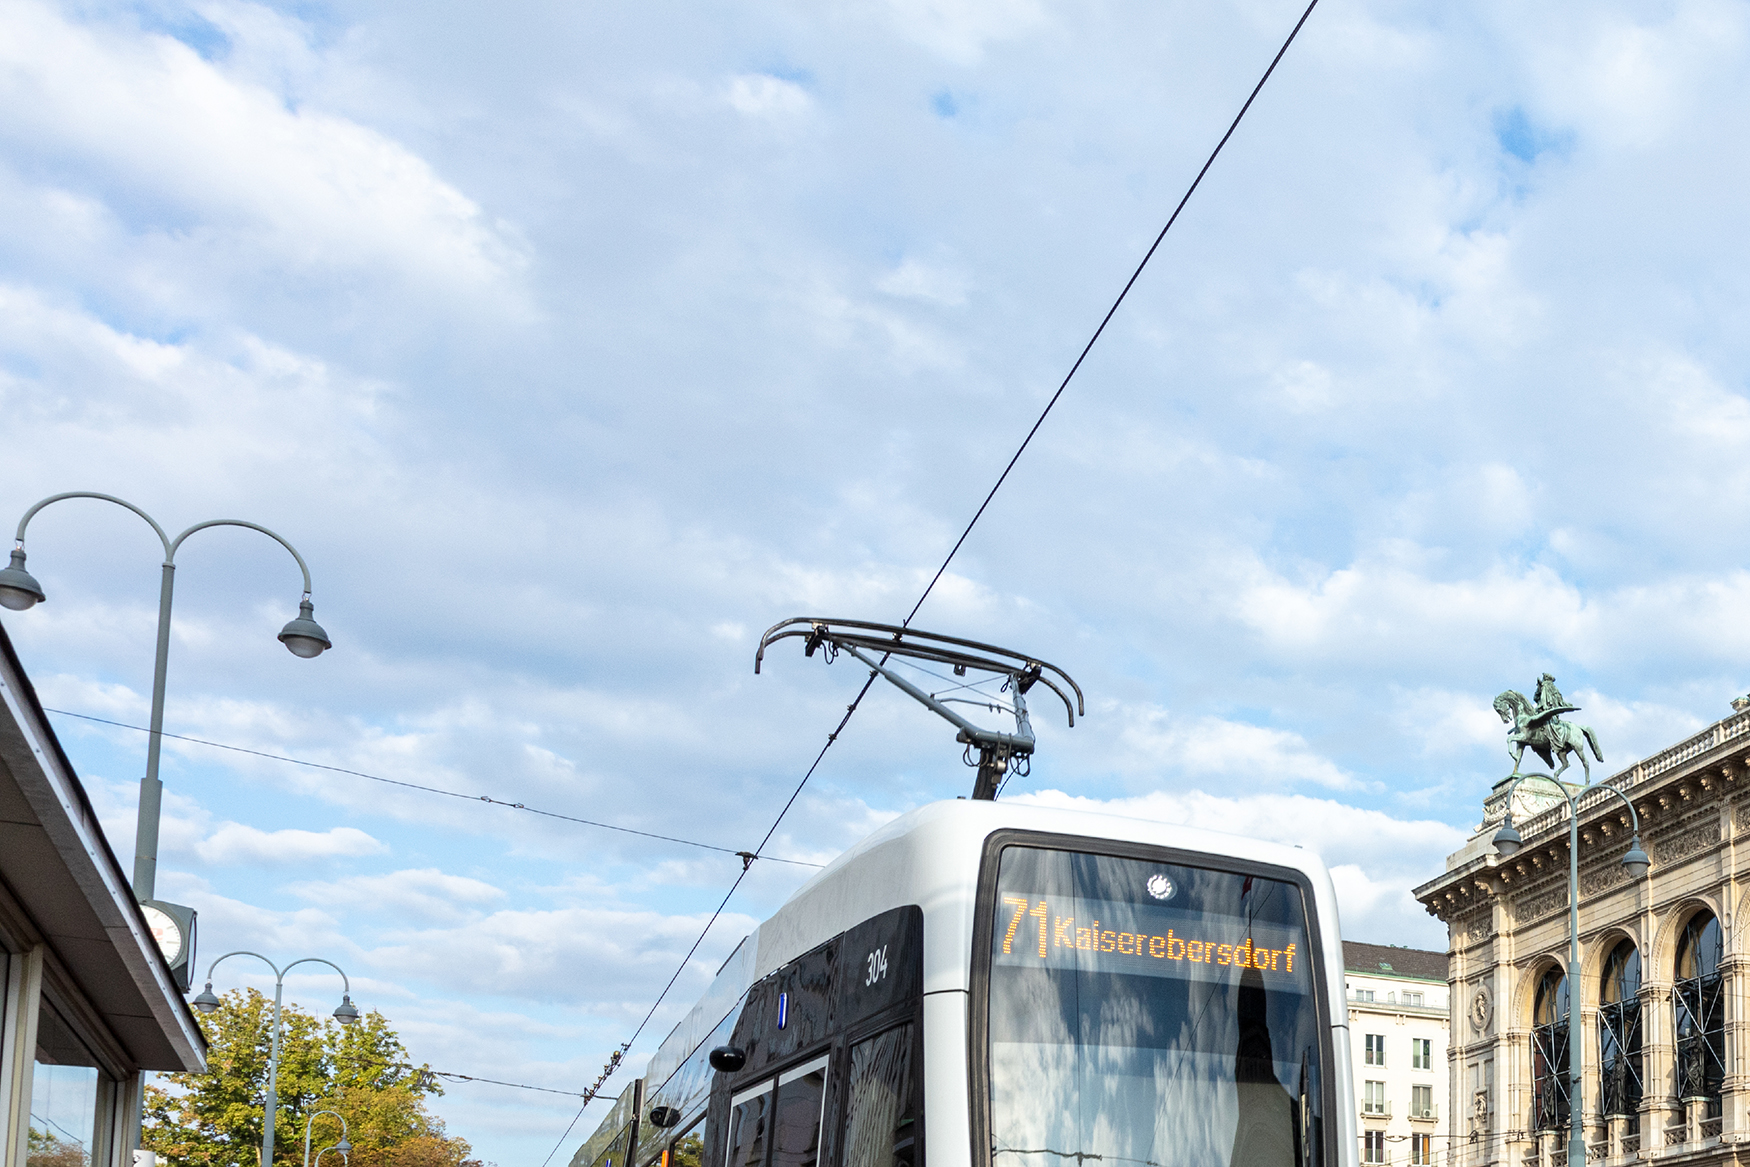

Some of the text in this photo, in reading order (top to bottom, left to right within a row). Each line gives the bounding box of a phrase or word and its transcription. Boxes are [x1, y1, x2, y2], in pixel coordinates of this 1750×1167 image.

[1002, 896, 1297, 973] 71 Kaiserebersdorf
[866, 944, 887, 987] 304
